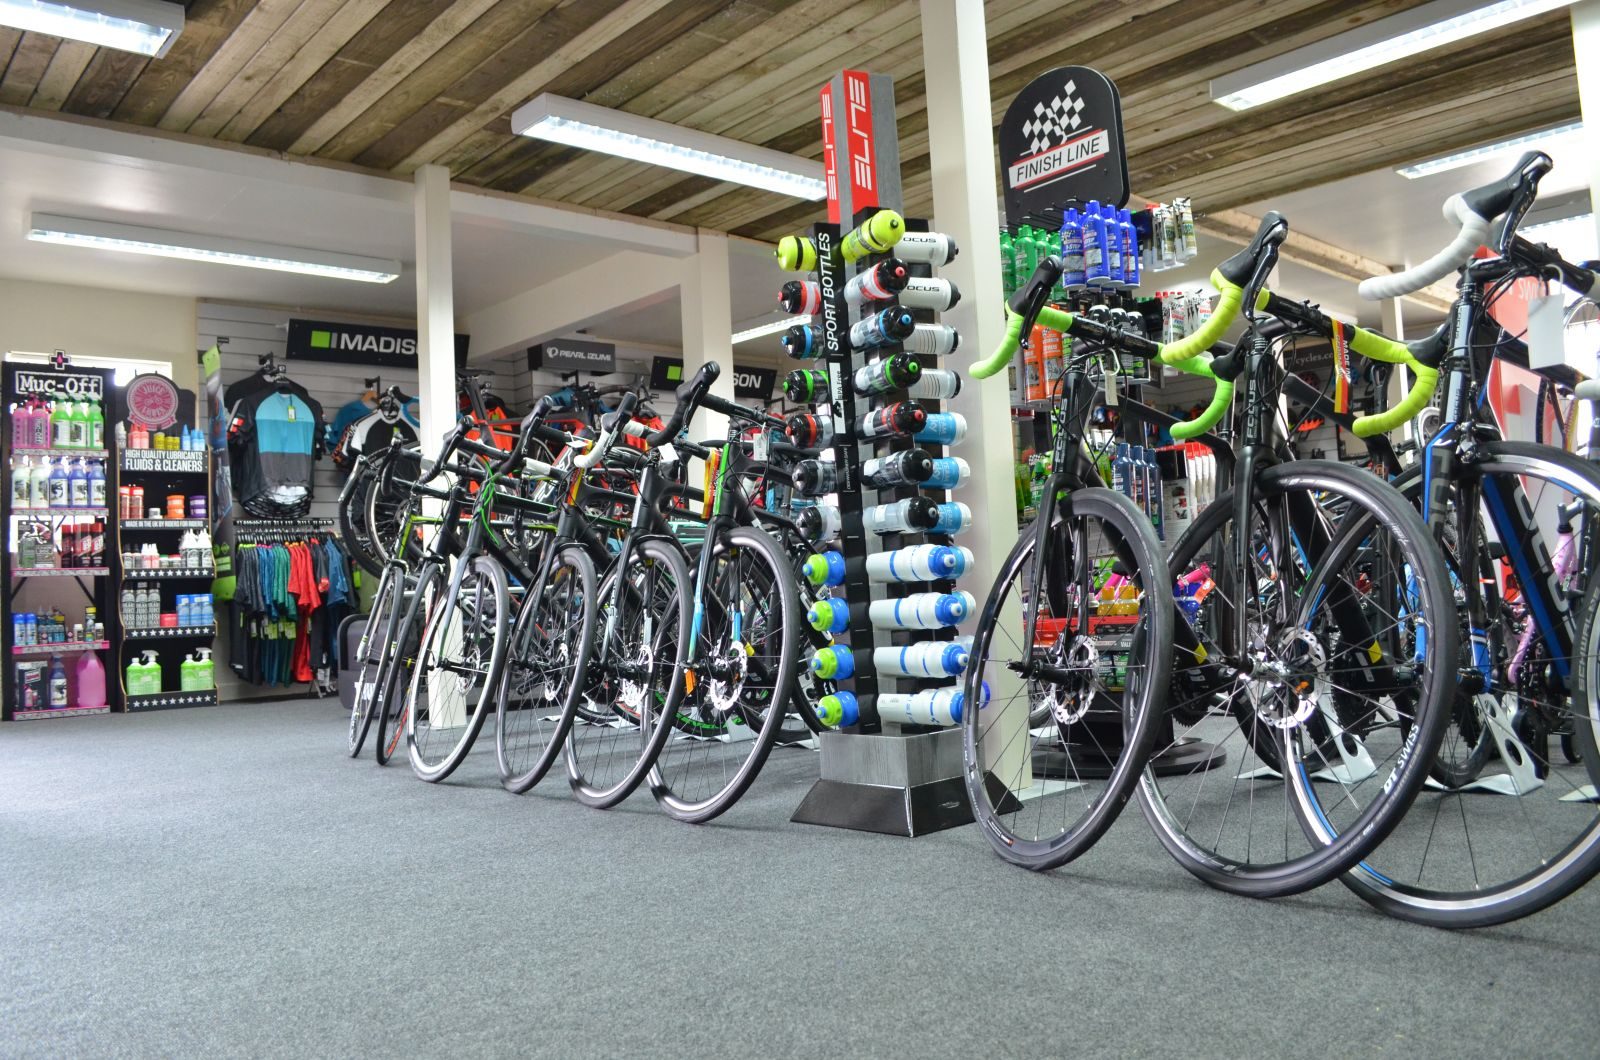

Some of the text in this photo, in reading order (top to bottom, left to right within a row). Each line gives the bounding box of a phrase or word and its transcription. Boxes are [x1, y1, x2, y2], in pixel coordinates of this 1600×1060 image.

[1016, 137, 1100, 182] FINISH LINE
[818, 232, 839, 351] SPORT BOTTLES
[340, 333, 418, 355] MADIS
[559, 350, 611, 362] PEARL IZUMI
[1343, 340, 1351, 367] MADE
[19, 374, 100, 396] Muc-Off
[1247, 379, 1257, 438] FOCUS
[125, 449, 203, 460] HIGH QUALITY LUBRICANTS
[125, 459, 203, 472] FLUIDS & CLEANERS
[1383, 723, 1419, 795] DT SWISS
